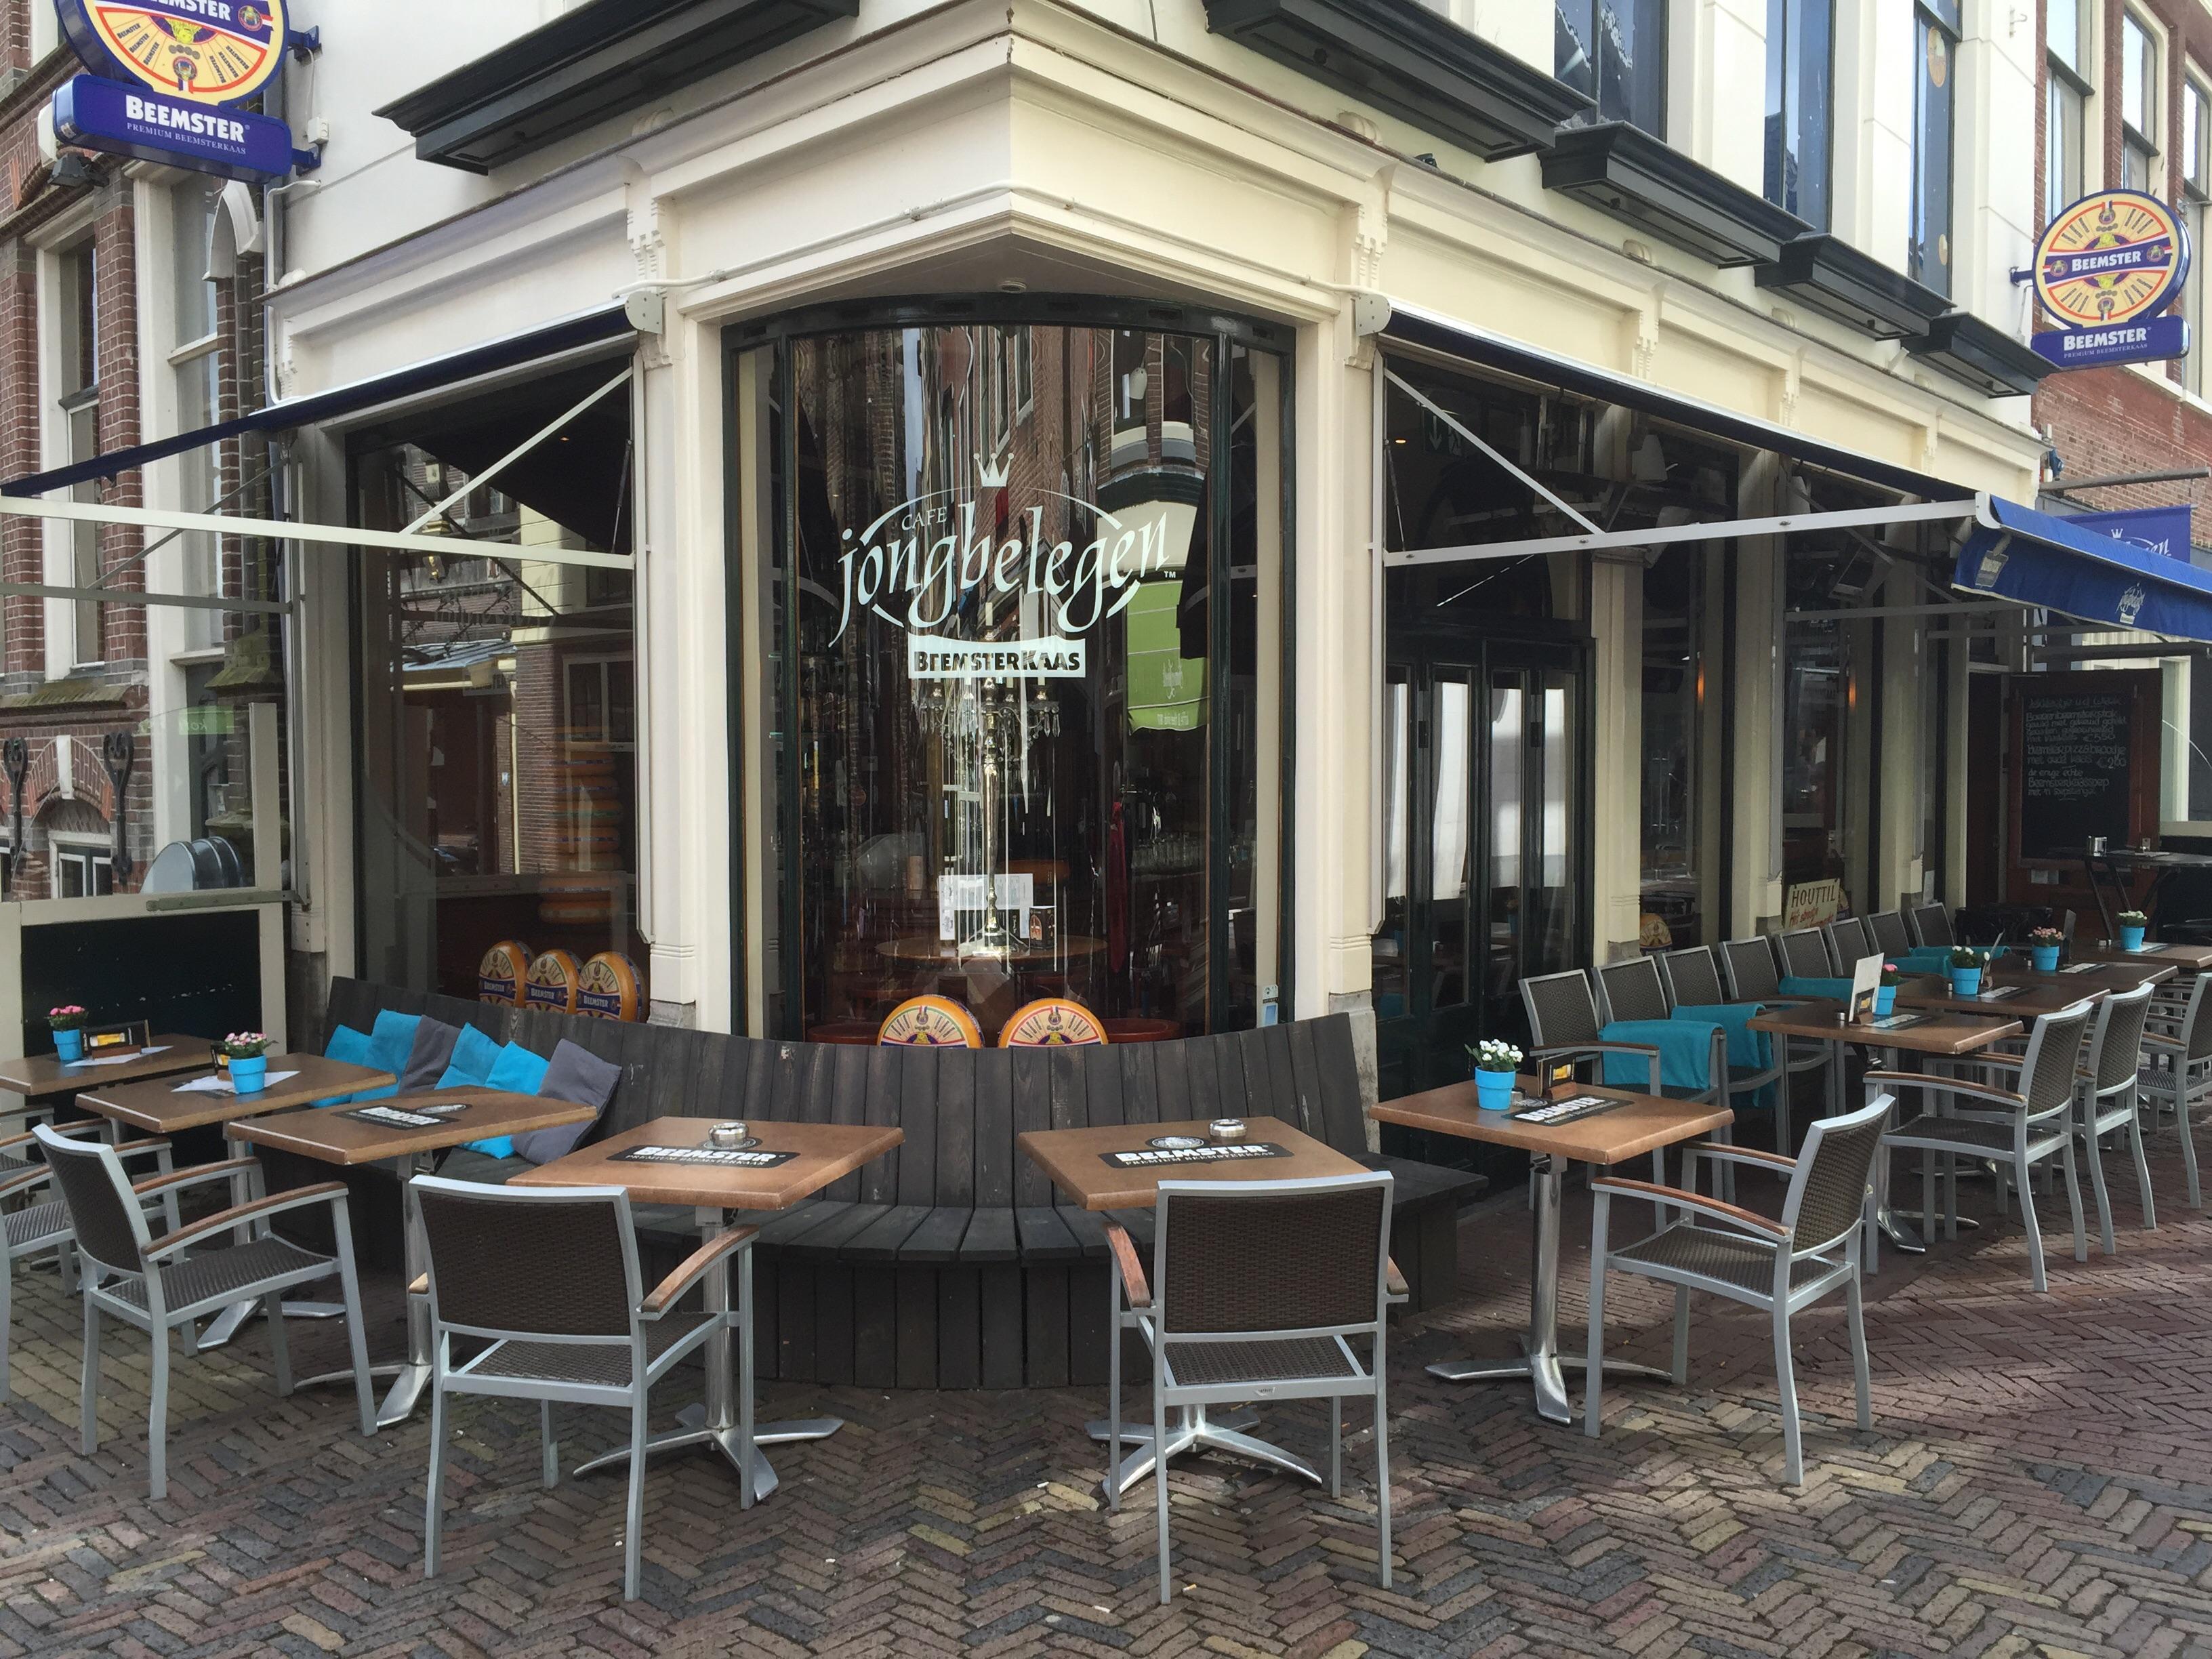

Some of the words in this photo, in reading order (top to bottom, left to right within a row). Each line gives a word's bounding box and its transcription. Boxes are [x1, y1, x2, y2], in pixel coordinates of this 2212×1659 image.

[125, 94, 245, 143] BEEMSTER
[127, 122, 173, 139] PREMIUM
[175, 132, 246, 155] BEEMSTERKAAS
[2072, 250, 2142, 272] BEEMSTER
[2064, 327, 2147, 351] BEEMSTER
[2064, 349, 2095, 359] PREMIUM
[2096, 343, 2148, 354] BEEMSTERKAAS
[828, 501, 1170, 649] jongbelegen
[914, 650, 1080, 672] BEEMSTERKAAS
[1791, 885, 1835, 908] HOUTTIL
[1115, 1145, 1268, 1162] BEEMSTER
